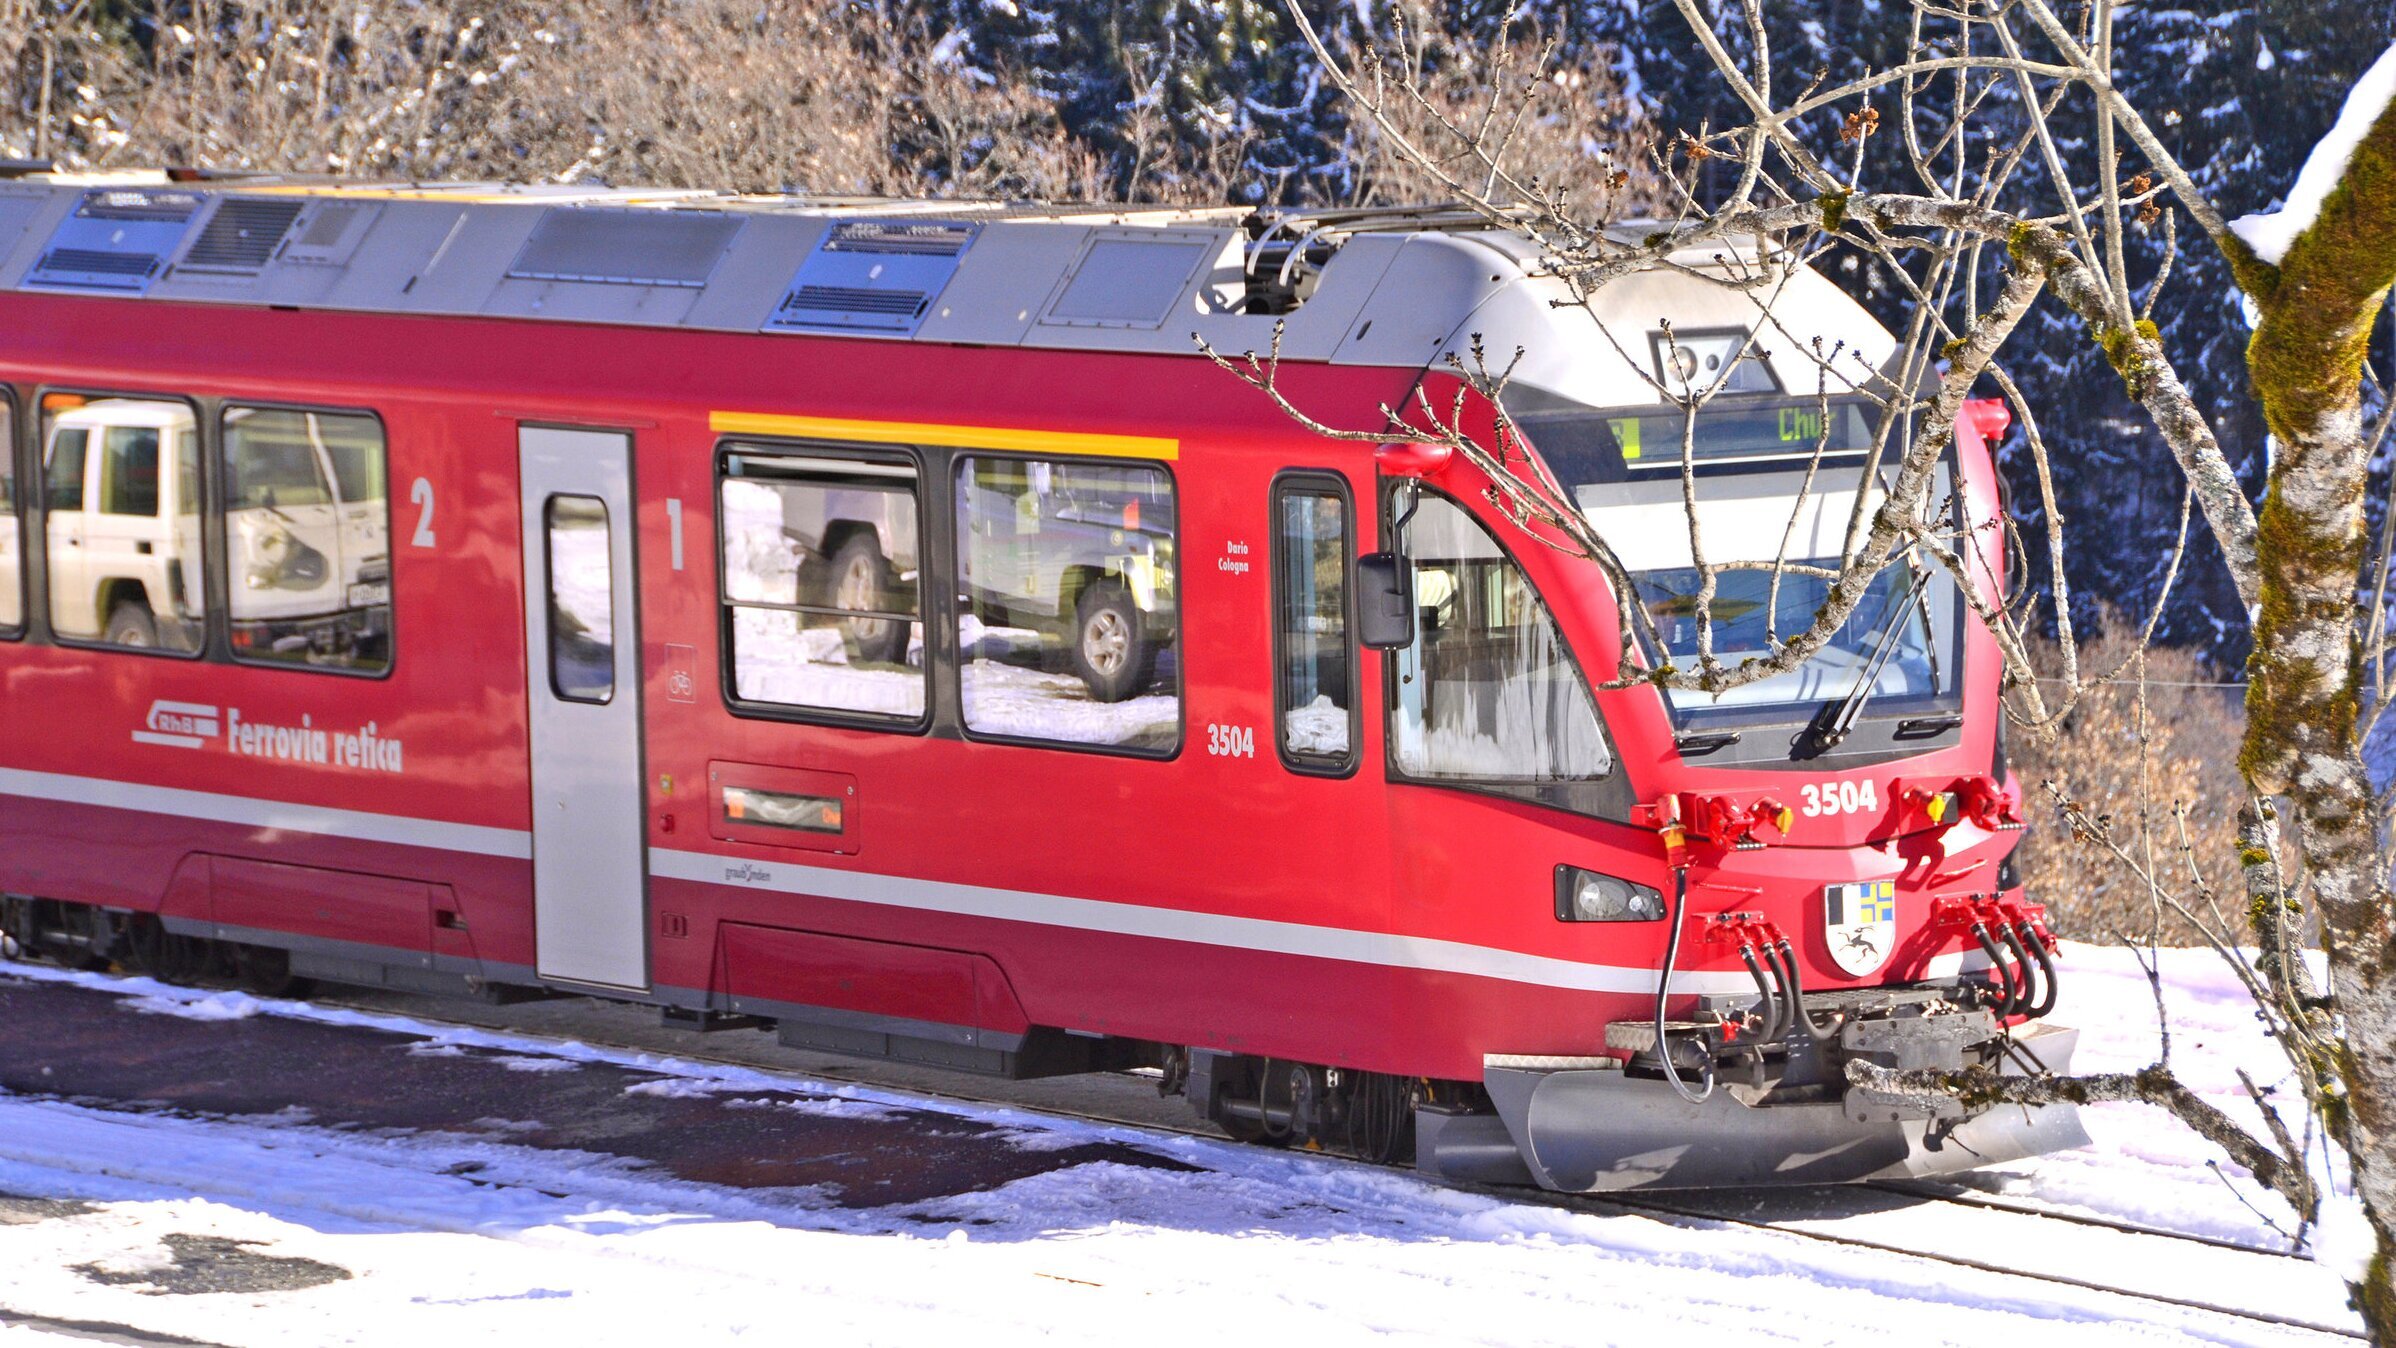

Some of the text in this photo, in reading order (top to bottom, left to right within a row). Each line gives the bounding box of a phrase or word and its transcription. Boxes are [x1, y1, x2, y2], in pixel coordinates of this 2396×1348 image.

[1779, 407, 1837, 440] Chu
[411, 477, 435, 548] 2
[666, 498, 683, 570] 1
[1227, 540, 1248, 555] Dario
[1218, 558, 1249, 575] Cologna
[158, 714, 194, 734] RhB
[227, 707, 403, 773] Ferrovia retica
[1207, 723, 1255, 758] 3504
[1800, 779, 1878, 817] 3504
